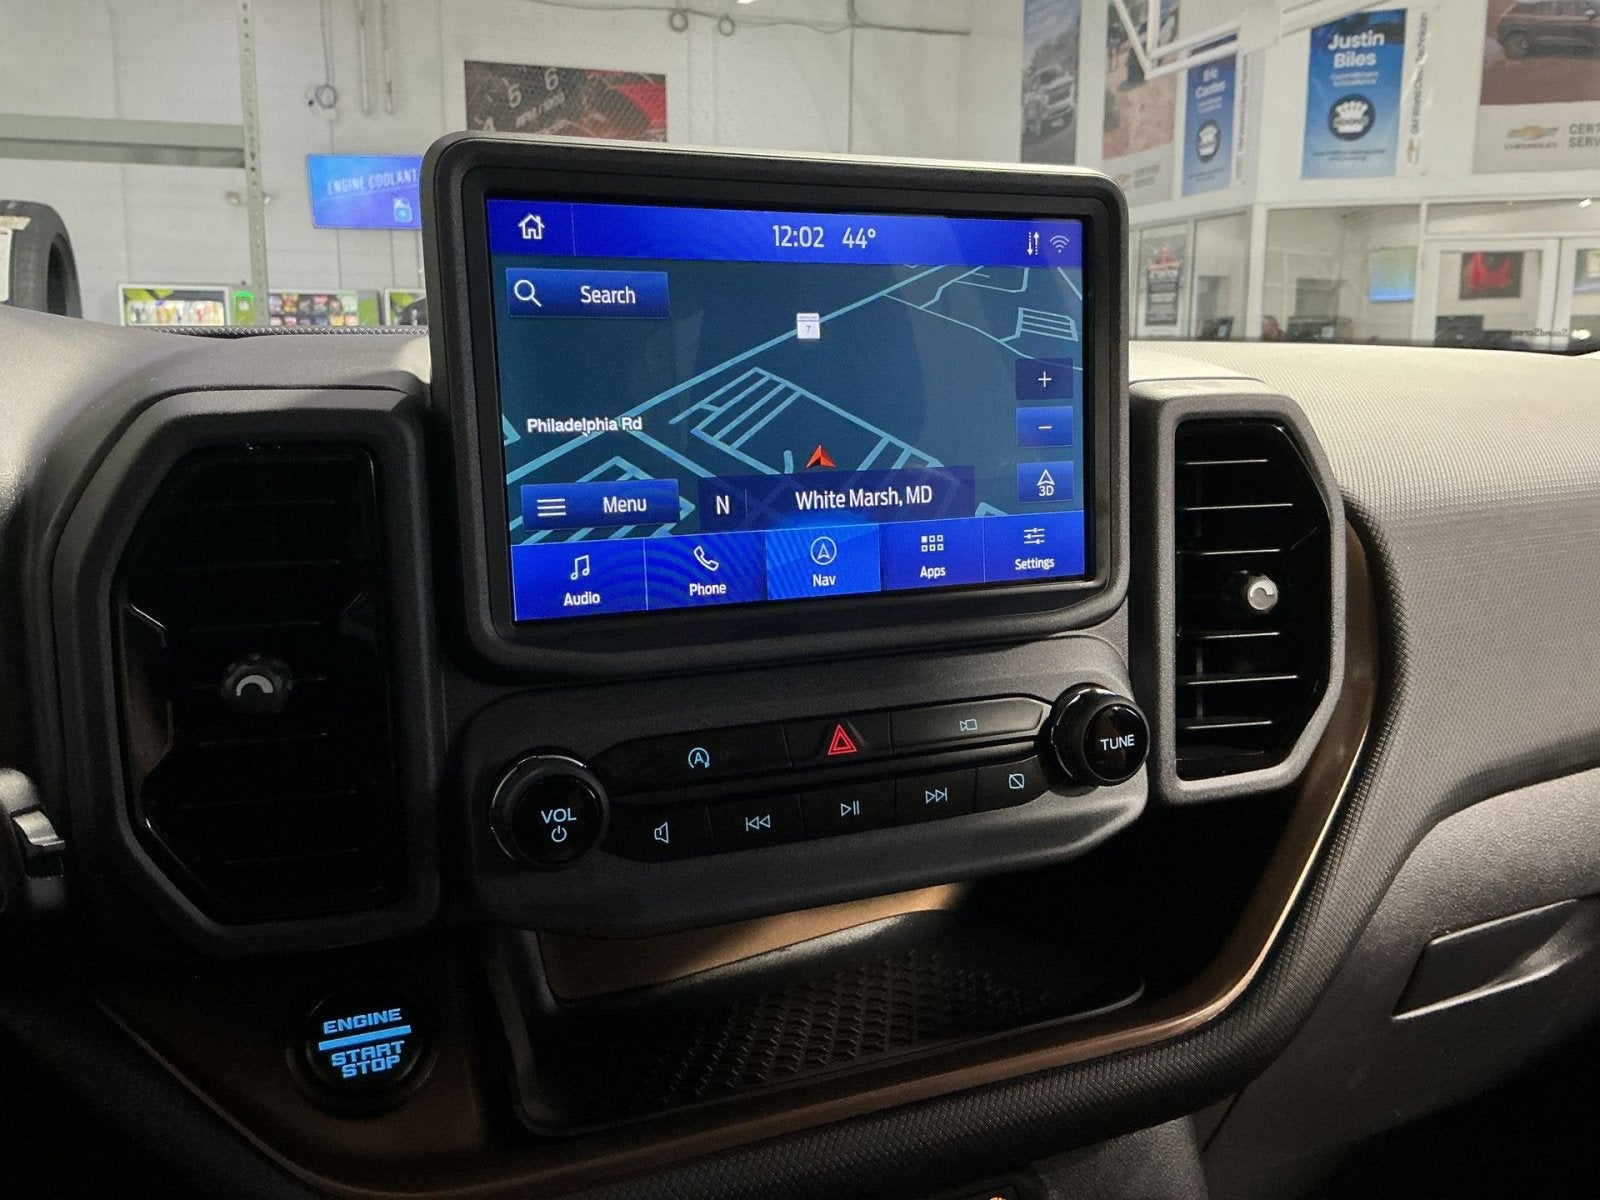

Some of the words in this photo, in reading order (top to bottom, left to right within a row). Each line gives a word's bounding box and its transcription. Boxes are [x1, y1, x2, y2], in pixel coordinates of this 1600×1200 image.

[1328, 30, 1385, 50] Justin
[1333, 52, 1377, 69] Biles
[327, 175, 365, 196] ENGINE
[368, 168, 418, 190] COOLANT
[772, 224, 825, 248] 12:02
[842, 228, 877, 249] 44°
[580, 285, 636, 304] Search
[526, 418, 618, 437] Philadelphia
[621, 416, 644, 431] Rd
[795, 489, 846, 511] White
[849, 486, 903, 508] Marsh,
[906, 485, 933, 504] MD
[1038, 485, 1055, 497] 3D
[603, 496, 647, 514] Menu
[715, 495, 730, 515] N
[919, 565, 946, 580] Apps
[1014, 557, 1055, 572] Settings
[689, 582, 727, 597] Phone
[812, 573, 836, 588] Nav
[563, 591, 601, 607] Audio
[1100, 734, 1135, 751] TUNE
[540, 807, 577, 824] VOL
[323, 1008, 403, 1035] ENGINE
[331, 1040, 405, 1067] START
[342, 1055, 401, 1079] STOP
